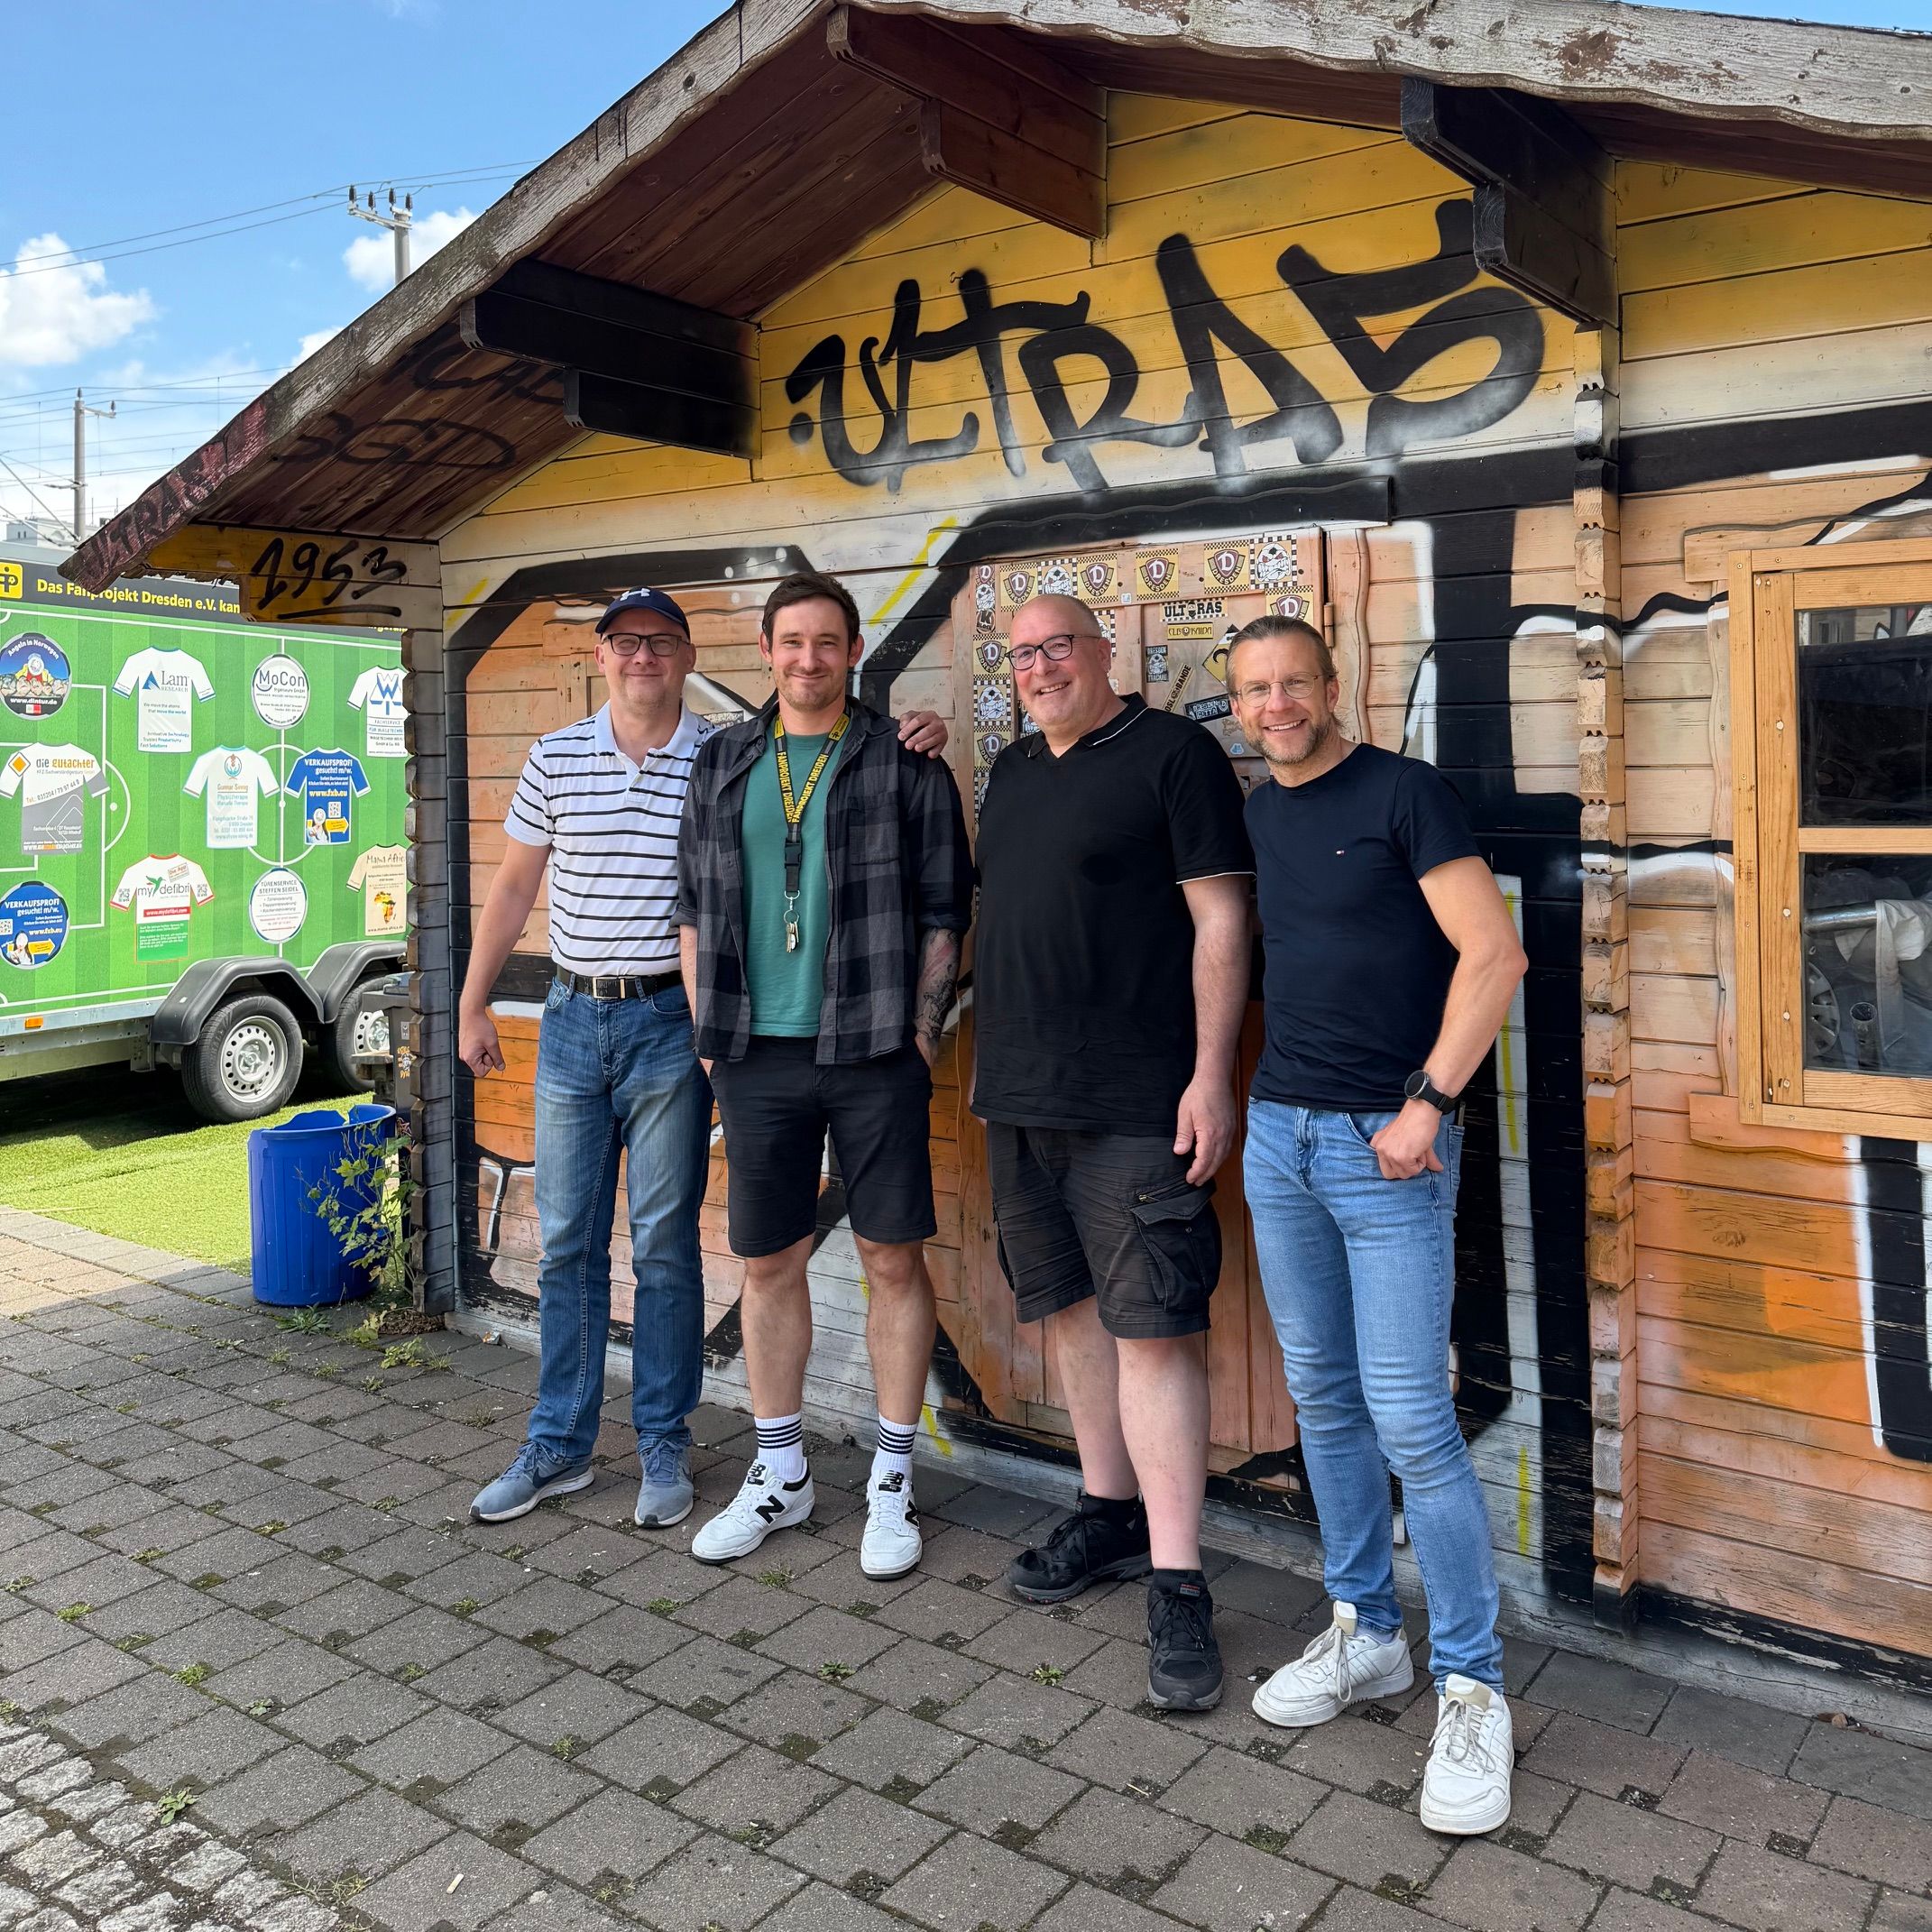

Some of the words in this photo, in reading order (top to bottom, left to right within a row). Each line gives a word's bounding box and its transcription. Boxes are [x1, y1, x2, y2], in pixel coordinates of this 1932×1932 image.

[786, 198, 1544, 492] ULTRAS
[251, 536, 407, 611] 1953
[1211, 566, 1242, 585] DRESDEN
[1084, 577, 1111, 597] DRESDEN
[1144, 574, 1172, 592] DRESDEN
[37, 578, 63, 594] Das
[142, 591, 192, 609] Dresden
[195, 599, 216, 612] e.V.
[1006, 586, 1033, 604] DRESDEN
[1164, 604, 1186, 618] ULT
[1197, 601, 1222, 615] RAS
[7, 641, 27, 657] Angeln
[33, 639, 60, 659] Norwegen
[980, 658, 1004, 674] DRESDEN
[161, 670, 189, 686] Lam
[259, 669, 305, 687] MoCon
[1164, 699, 1176, 712] OSL
[1175, 664, 1191, 689] BANDE
[36, 758, 50, 768] die
[52, 759, 95, 769] gutachter
[305, 759, 352, 767] VERKAUFSPROFI
[777, 750, 792, 792] FANPROJEKT
[792, 781, 815, 823] FANPROJEKT
[808, 752, 830, 783] DRESDEN
[388, 851, 405, 862] Afric
[137, 887, 153, 897] my
[159, 882, 189, 895] defibri
[5, 898, 60, 909] VERKAUFSPROFI
